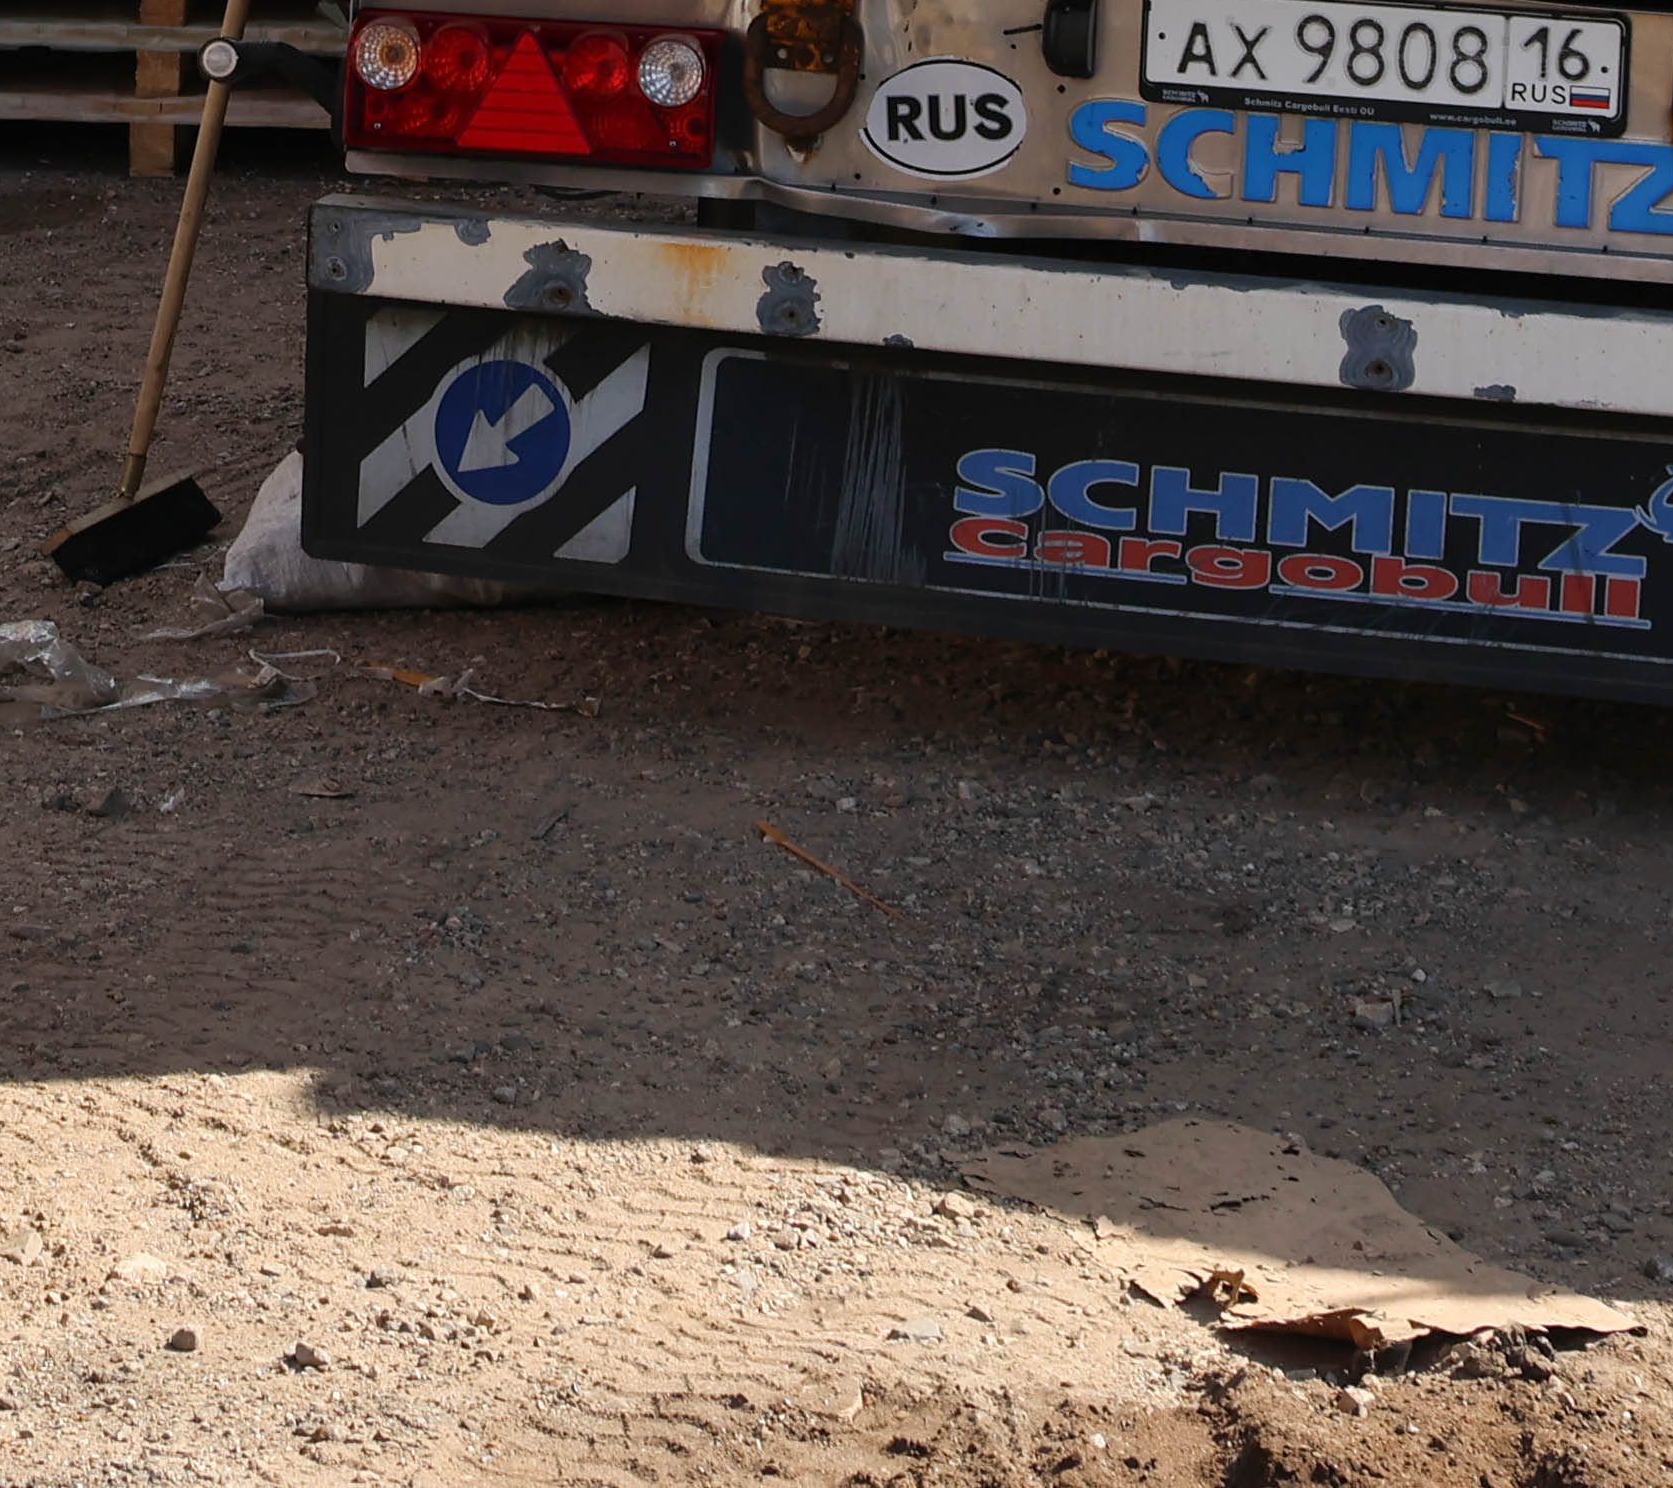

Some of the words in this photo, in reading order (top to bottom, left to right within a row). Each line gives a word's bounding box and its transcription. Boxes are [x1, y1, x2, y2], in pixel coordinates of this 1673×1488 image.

[1295, 13, 1490, 94] 9808
[1520, 26, 1591, 82] 16
[884, 92, 1013, 143] RUS
[1244, 96, 1283, 110] Schmitz
[1509, 82, 1567, 106] RUS
[953, 448, 1647, 577] SCHMITZ
